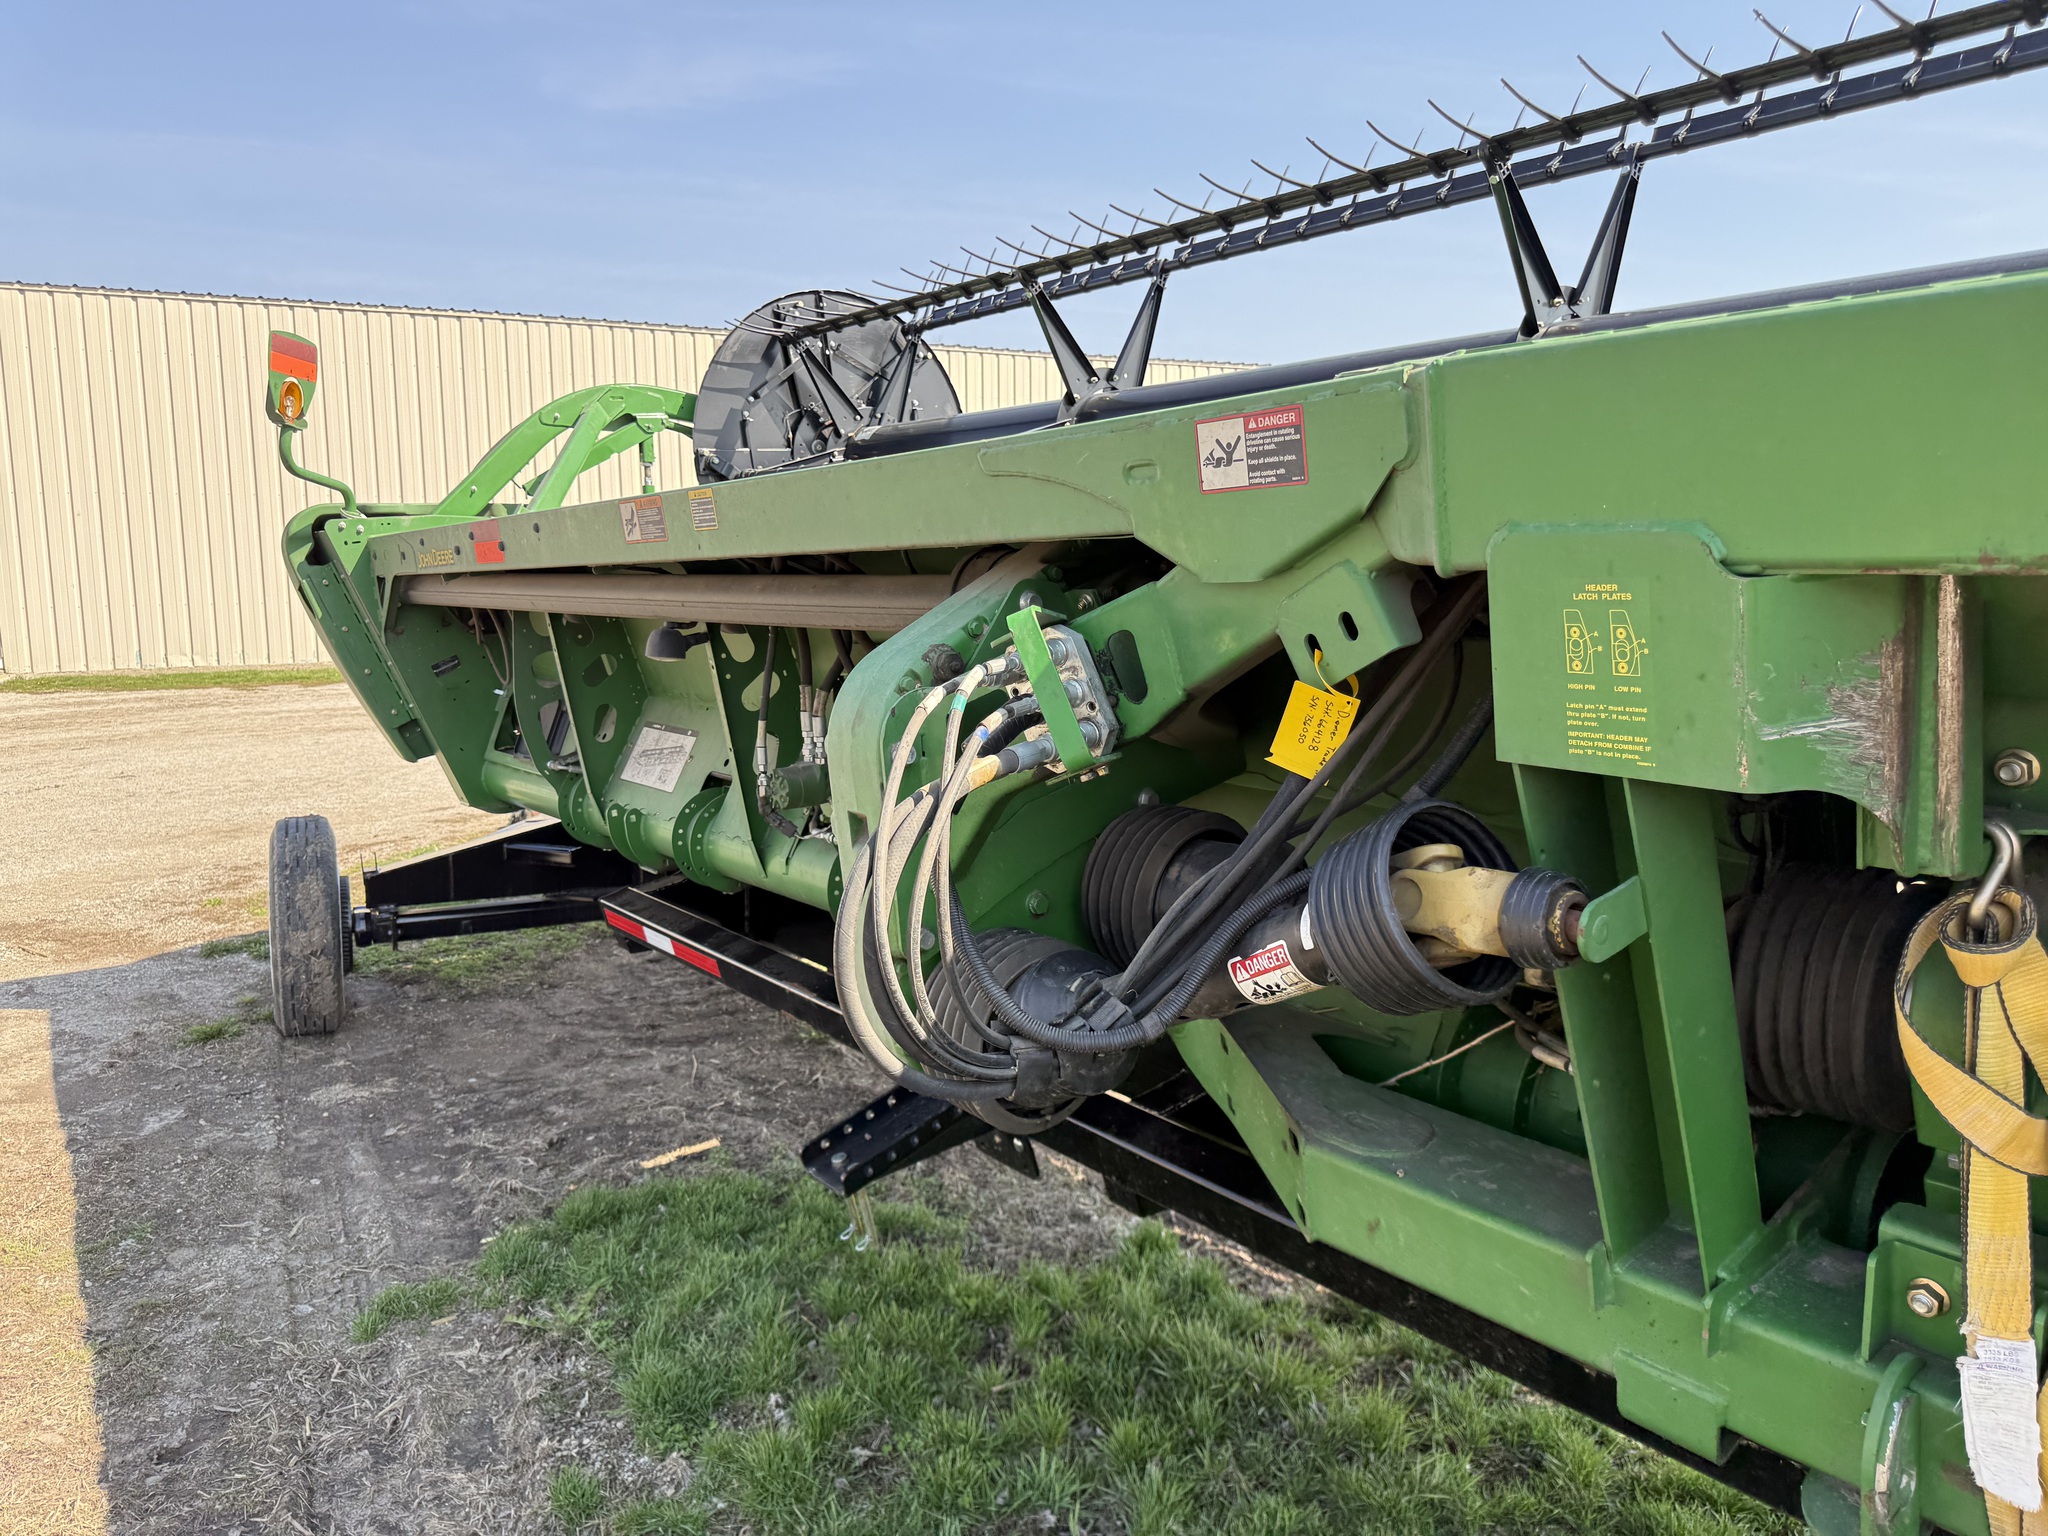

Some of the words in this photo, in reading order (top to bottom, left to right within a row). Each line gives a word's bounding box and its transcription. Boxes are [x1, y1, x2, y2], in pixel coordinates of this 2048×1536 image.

[1258, 412, 1296, 428] DANGER
[1246, 430, 1273, 439] Entanglement
[1278, 427, 1294, 435] rotating
[418, 551, 433, 568] JOHN
[432, 548, 455, 566] DEERE
[1568, 731, 1605, 739] IMPORTANT:
[1245, 948, 1288, 975] DANGER
